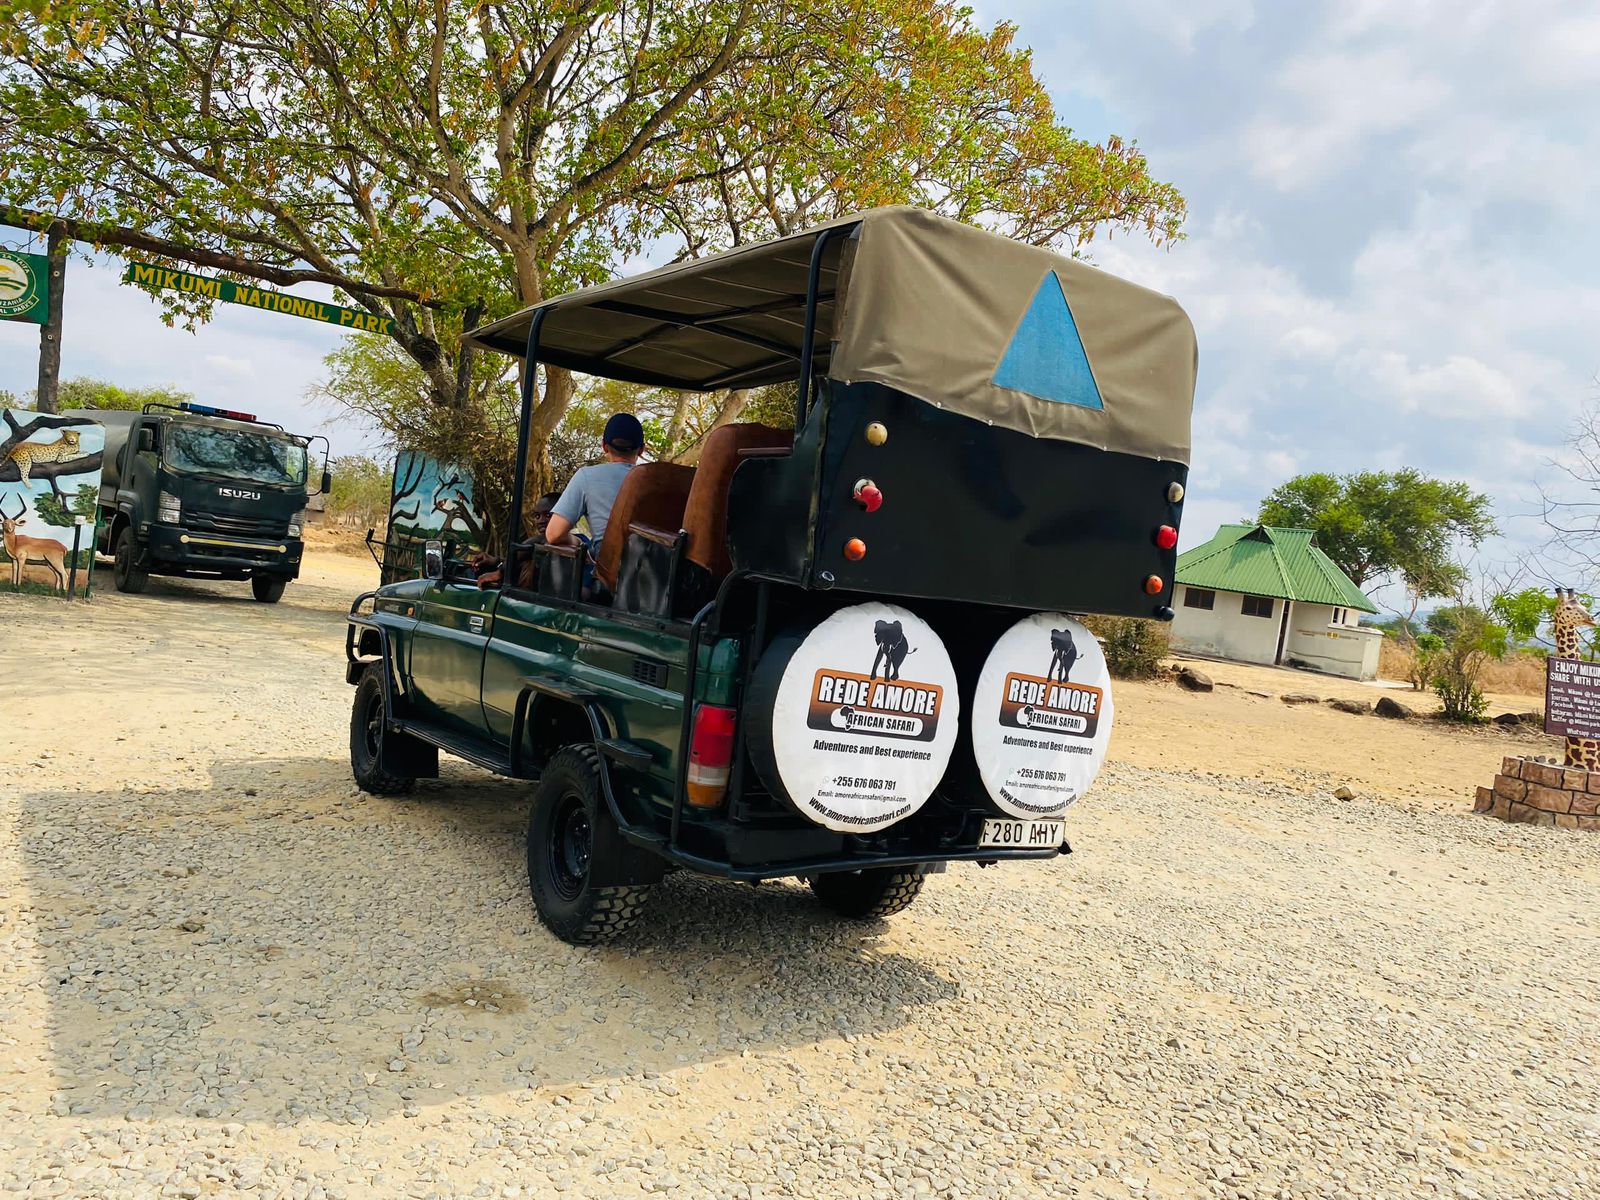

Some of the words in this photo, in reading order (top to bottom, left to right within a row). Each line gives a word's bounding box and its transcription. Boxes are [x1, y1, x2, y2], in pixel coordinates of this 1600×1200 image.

[134, 264, 222, 299] MIKUMI
[234, 286, 330, 322] NATIONAL
[340, 311, 392, 335] PARK
[219, 487, 261, 501] ISUZU
[1555, 661, 1578, 675] ENJOY
[1550, 672, 1570, 683] SHARE
[1573, 675, 1591, 686] WITH
[819, 676, 870, 707] REDE
[871, 683, 938, 716] AMORE
[1008, 679, 1047, 706] REDE
[1047, 686, 1098, 714] AMORE
[847, 713, 884, 729] AFRICAN
[886, 718, 915, 732] SAFARI
[1028, 711, 1059, 726] AFRICAN
[1058, 716, 1081, 729] SAFARI
[813, 739, 859, 754] Adventures
[859, 745, 874, 756] and
[874, 746, 891, 758] Best
[892, 750, 932, 761] experience
[1003, 735, 1038, 749] Adventures
[1038, 740, 1050, 750] and
[1050, 741, 1064, 752] Best
[1063, 745, 1093, 756] experience
[832, 776, 853, 788] +255
[854, 778, 868, 788] 676
[868, 779, 884, 790] 063
[884, 780, 897, 791] 791
[1017, 768, 1034, 779] +255
[1033, 769, 1045, 780] 676
[1045, 771, 1058, 782] 063
[818, 789, 834, 798] Email:
[999, 786, 1077, 814] www.amoreafricansafari.com
[808, 797, 911, 826] www.amoreafricansafari.com
[1029, 823, 1059, 844] AHY
